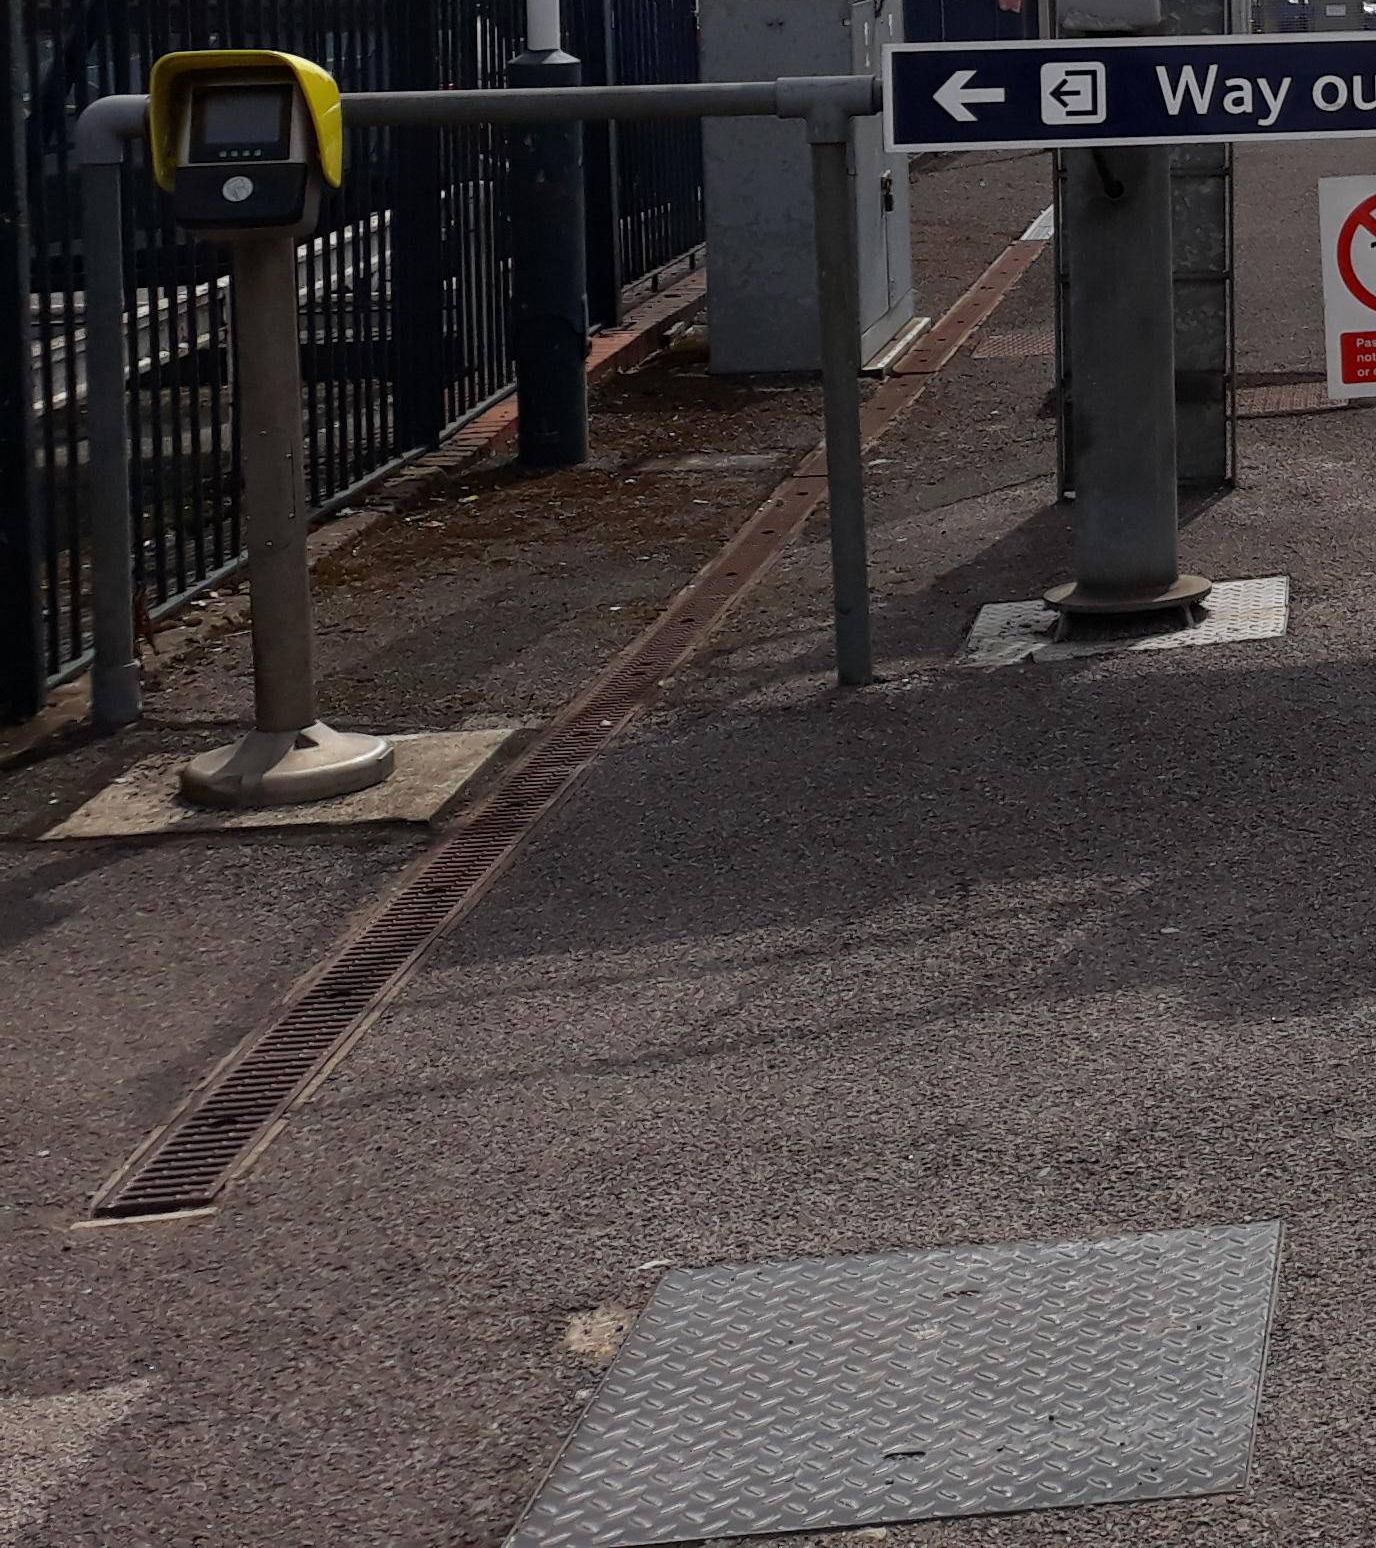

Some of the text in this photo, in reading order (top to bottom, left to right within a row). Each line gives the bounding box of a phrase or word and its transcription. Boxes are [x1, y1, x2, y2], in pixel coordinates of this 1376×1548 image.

[1155, 63, 1293, 127] Way
[1356, 352, 1376, 362] not
[1357, 368, 1370, 377] or
